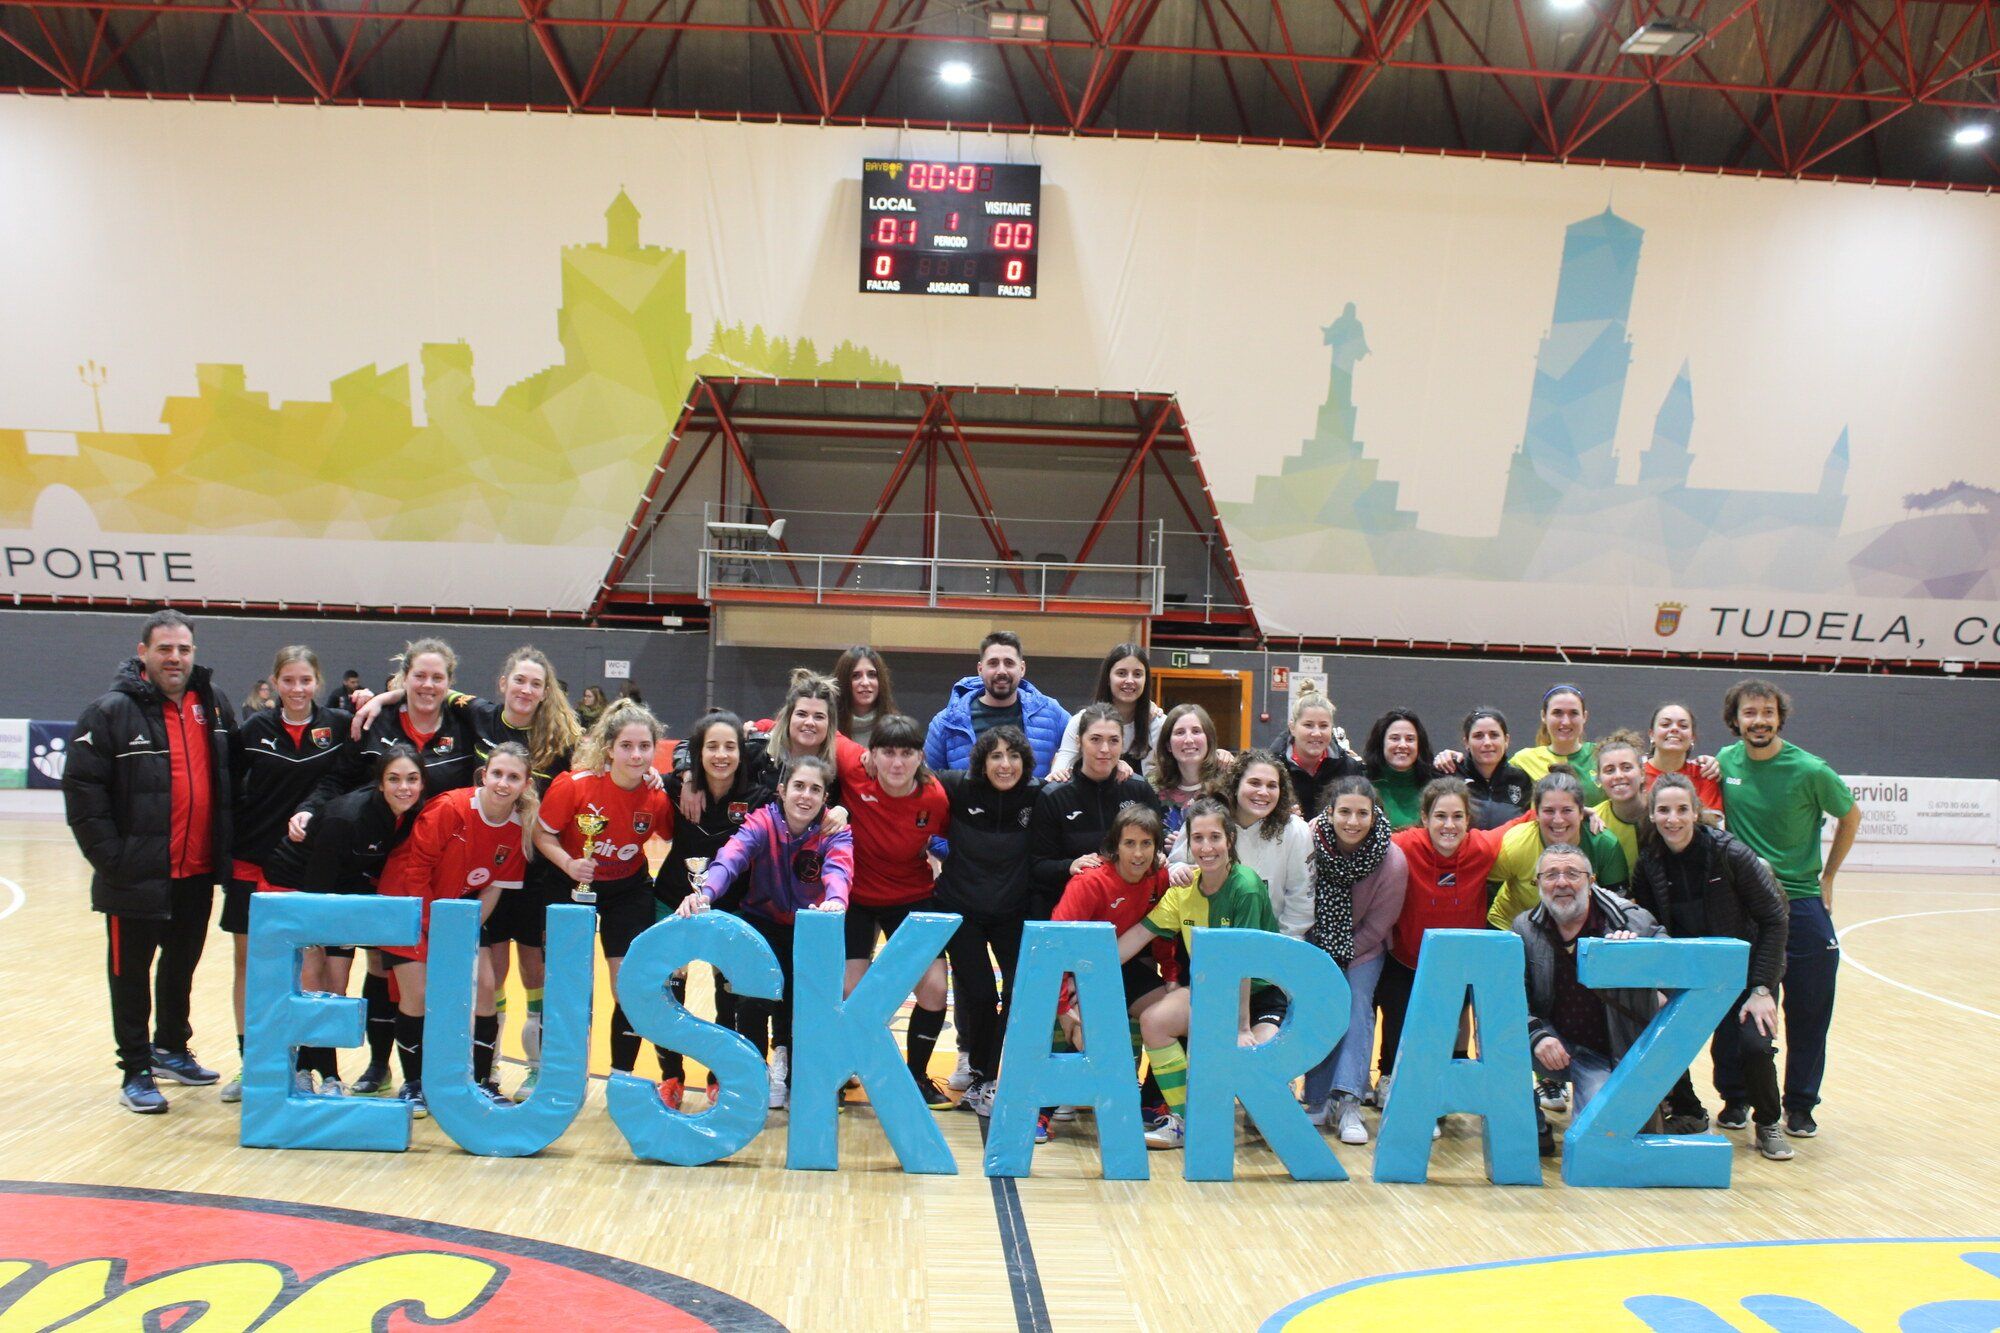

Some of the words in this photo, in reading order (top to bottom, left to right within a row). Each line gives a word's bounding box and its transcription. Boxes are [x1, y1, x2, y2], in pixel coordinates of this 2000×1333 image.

[869, 197, 916, 211] LOCAL
[985, 201, 1031, 216] VISITANTE
[934, 235, 968, 248] PERIODO
[994, 222, 1032, 249] 00
[876, 255, 891, 276] 0
[1007, 260, 1022, 280] 0
[866, 280, 900, 291] FALTAS
[927, 282, 969, 294] JUGADOR
[998, 285, 1031, 297] FALTAS
[1710, 607, 1925, 648] TUDELA,
[241, 892, 1750, 1188] EUSKARAZ
